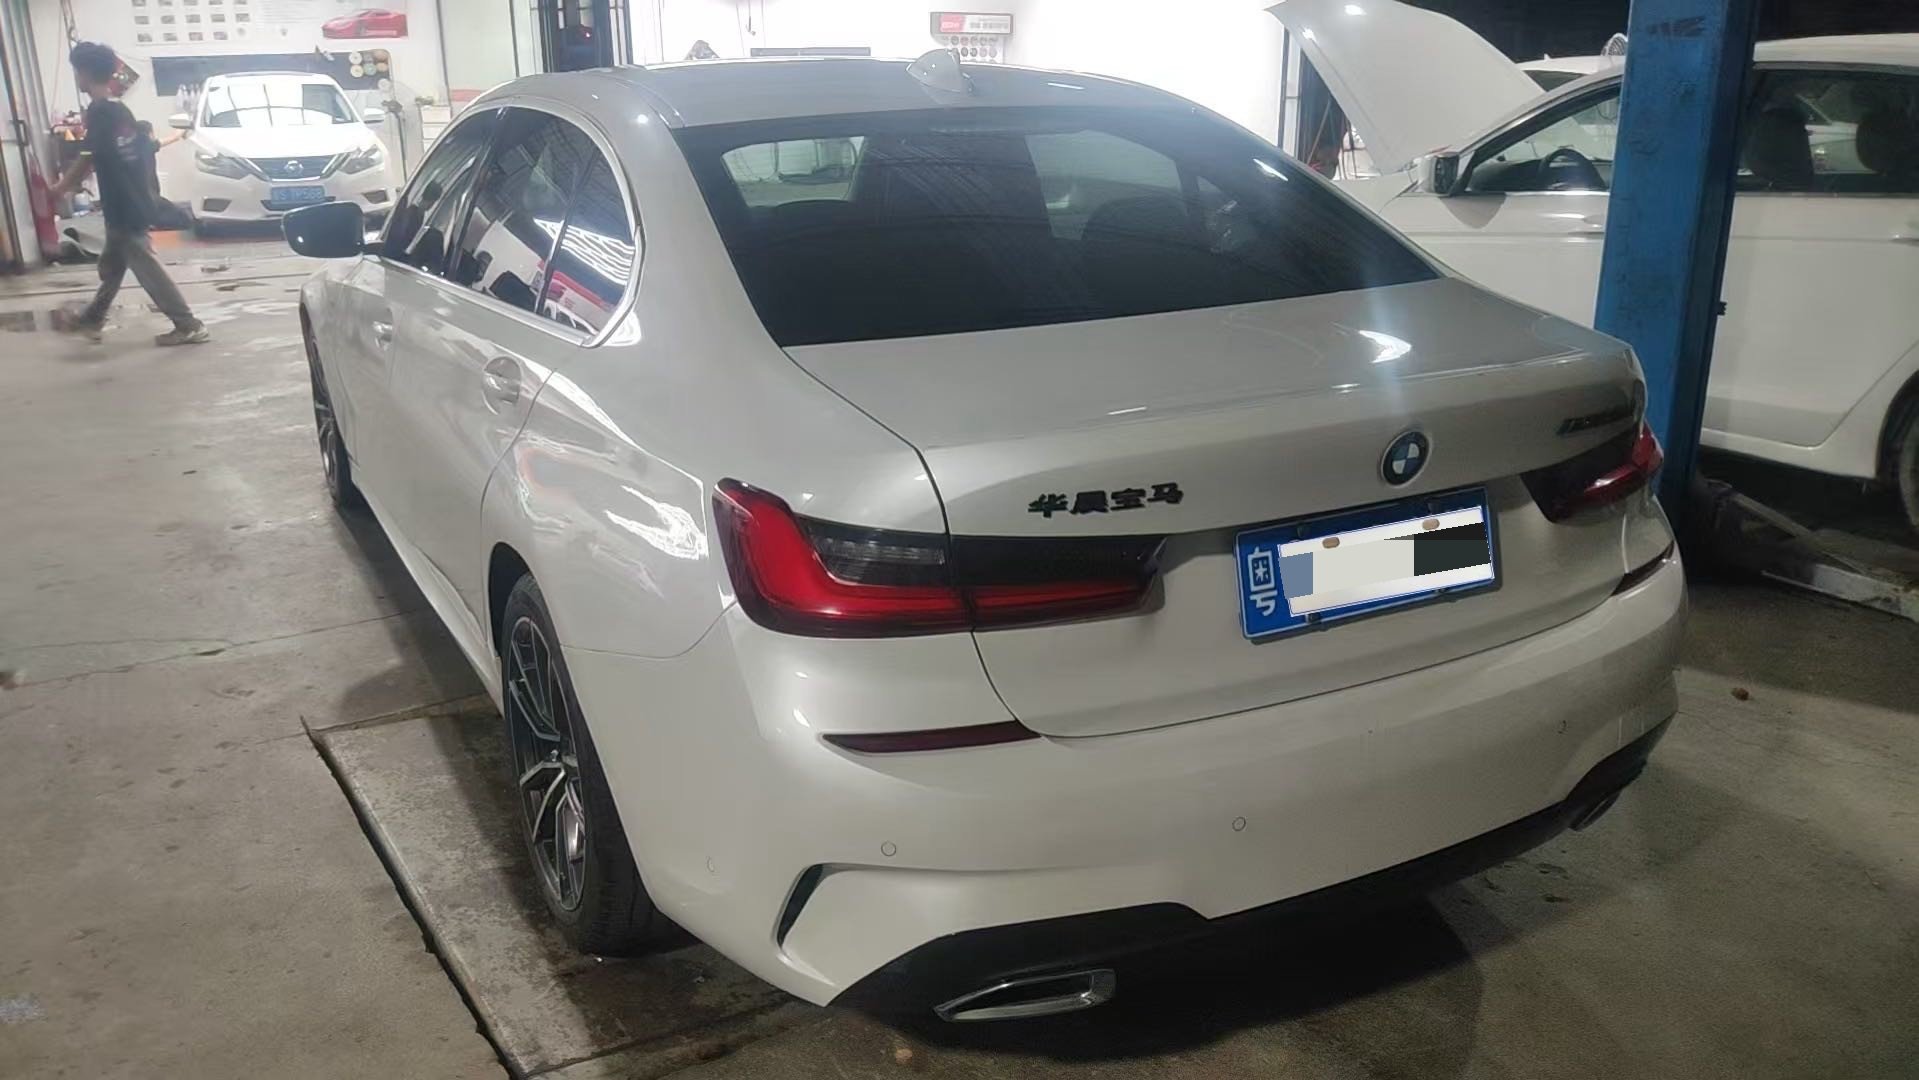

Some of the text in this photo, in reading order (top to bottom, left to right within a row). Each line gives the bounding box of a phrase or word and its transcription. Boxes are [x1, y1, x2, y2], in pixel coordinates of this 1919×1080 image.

[1027, 482, 1184, 519] 华晨宝马
[1247, 545, 1278, 617] 粤
